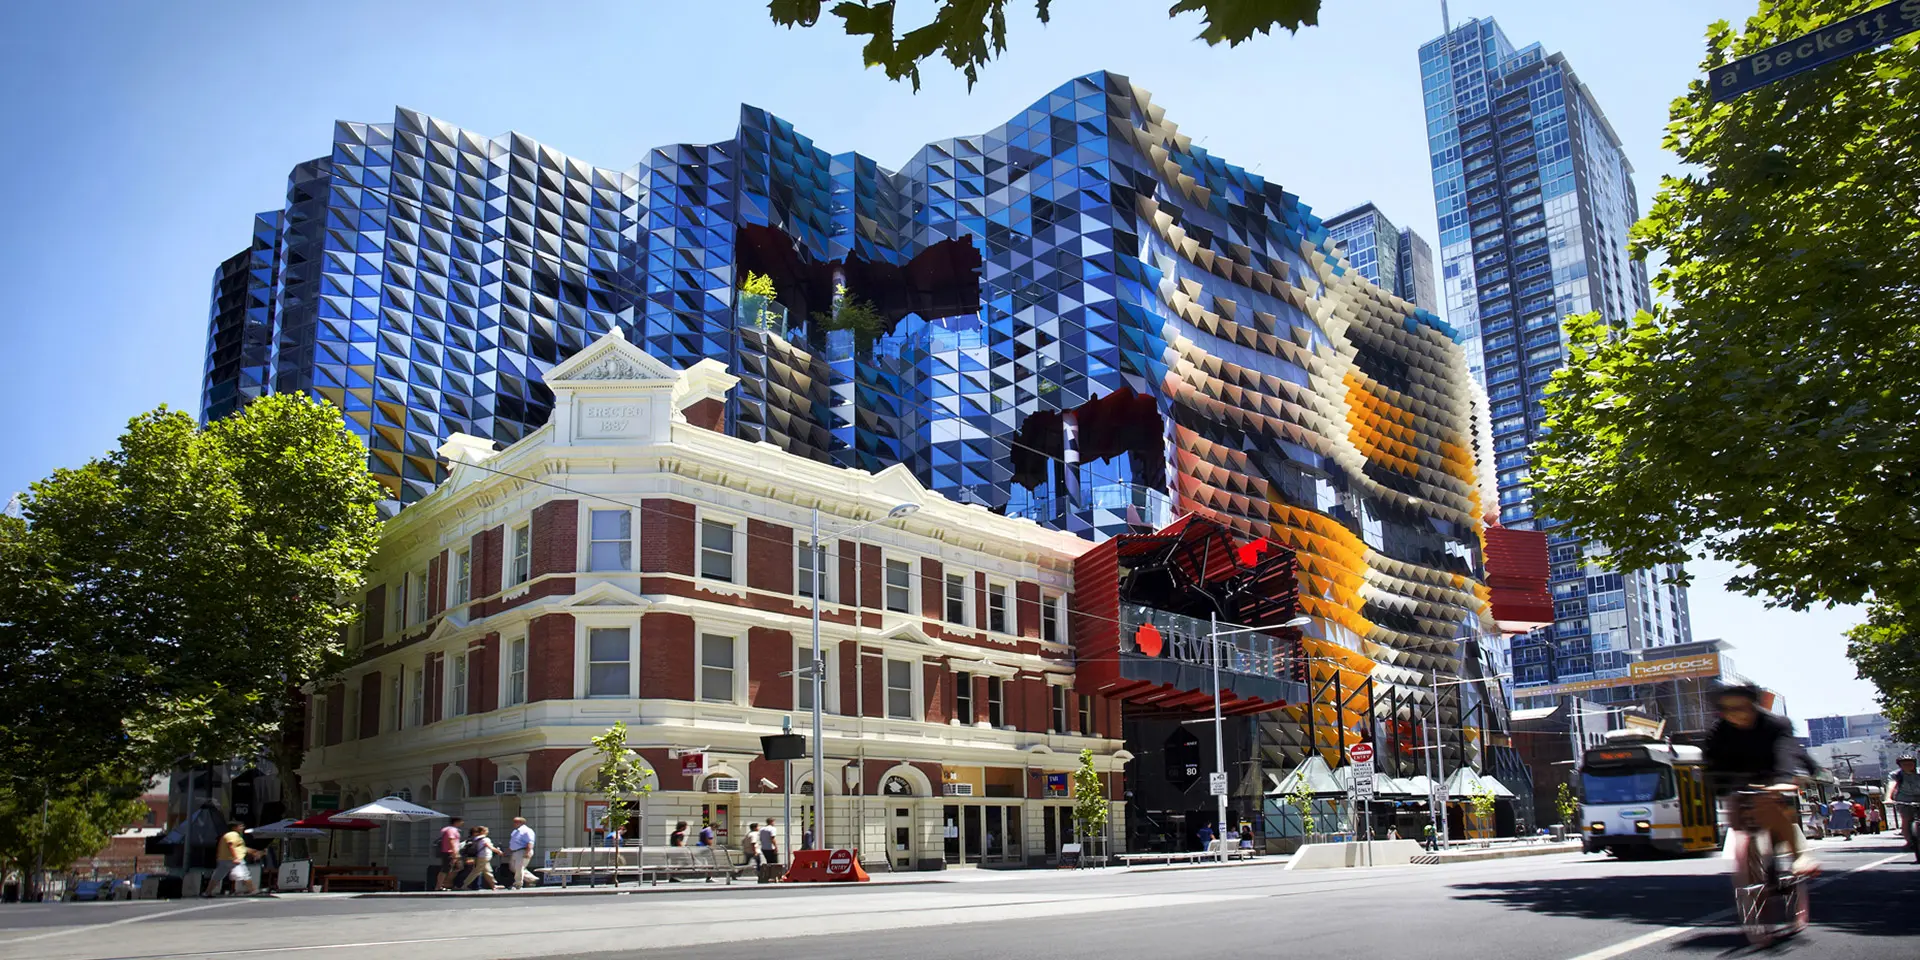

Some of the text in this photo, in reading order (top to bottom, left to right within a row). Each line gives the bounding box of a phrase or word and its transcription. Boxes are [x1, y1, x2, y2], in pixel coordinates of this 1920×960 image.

[588, 406, 643, 418] ERECTED
[601, 419, 629, 432] 1887
[1634, 658, 1713, 674] hardrock
[1186, 767, 1197, 776] 80
